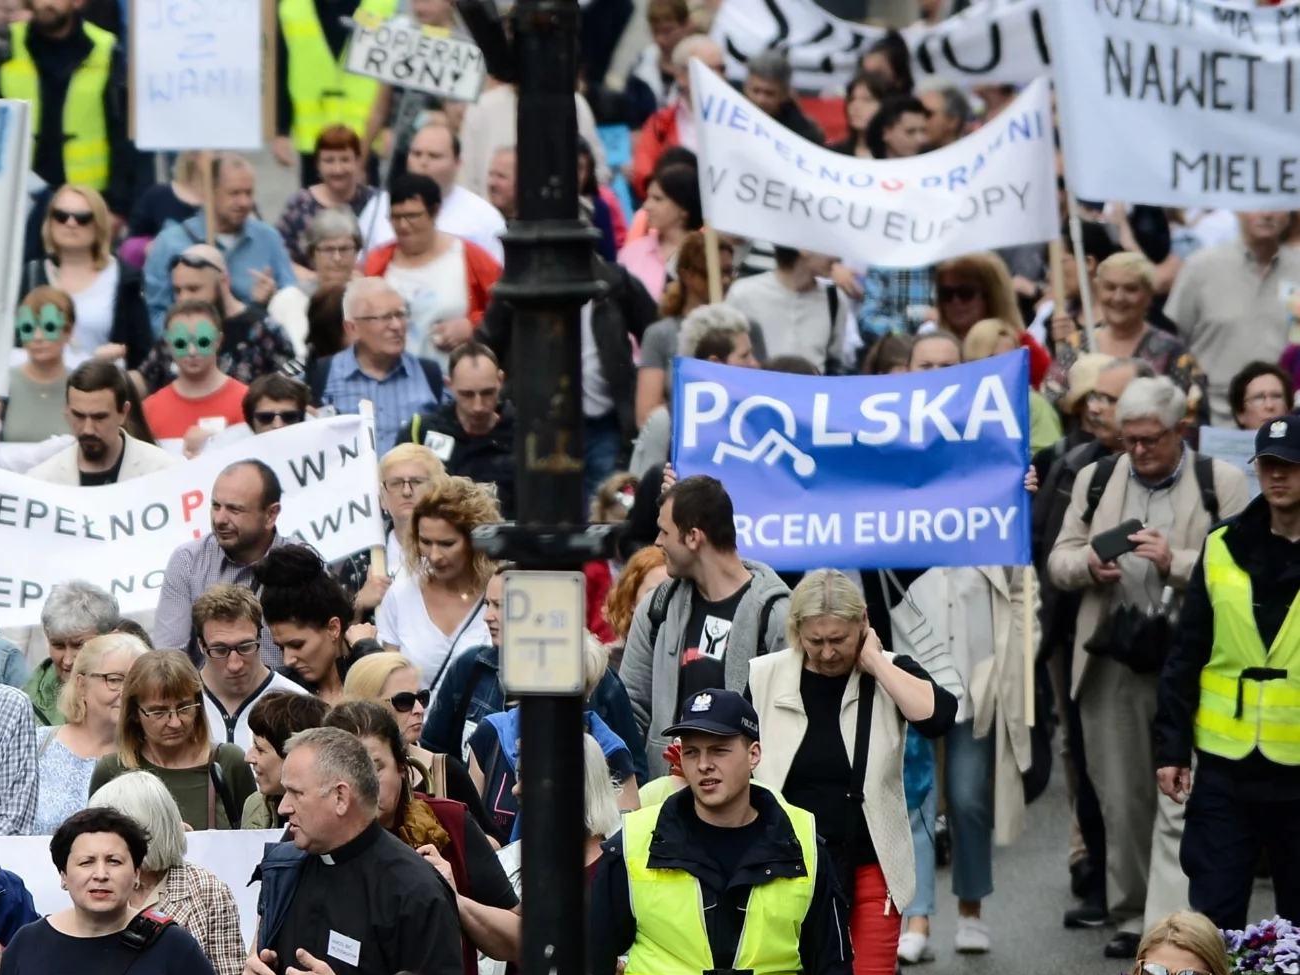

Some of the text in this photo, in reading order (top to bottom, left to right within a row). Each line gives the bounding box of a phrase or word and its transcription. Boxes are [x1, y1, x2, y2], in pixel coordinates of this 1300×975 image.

[176, 33, 217, 60] Z
[149, 67, 242, 101] WAMI
[1104, 36, 1262, 112] NAWET
[1172, 150, 1298, 194] MIELE
[734, 172, 872, 230] SERCU
[682, 374, 1022, 452] POLSKA
[854, 505, 1018, 544] EUROPY
